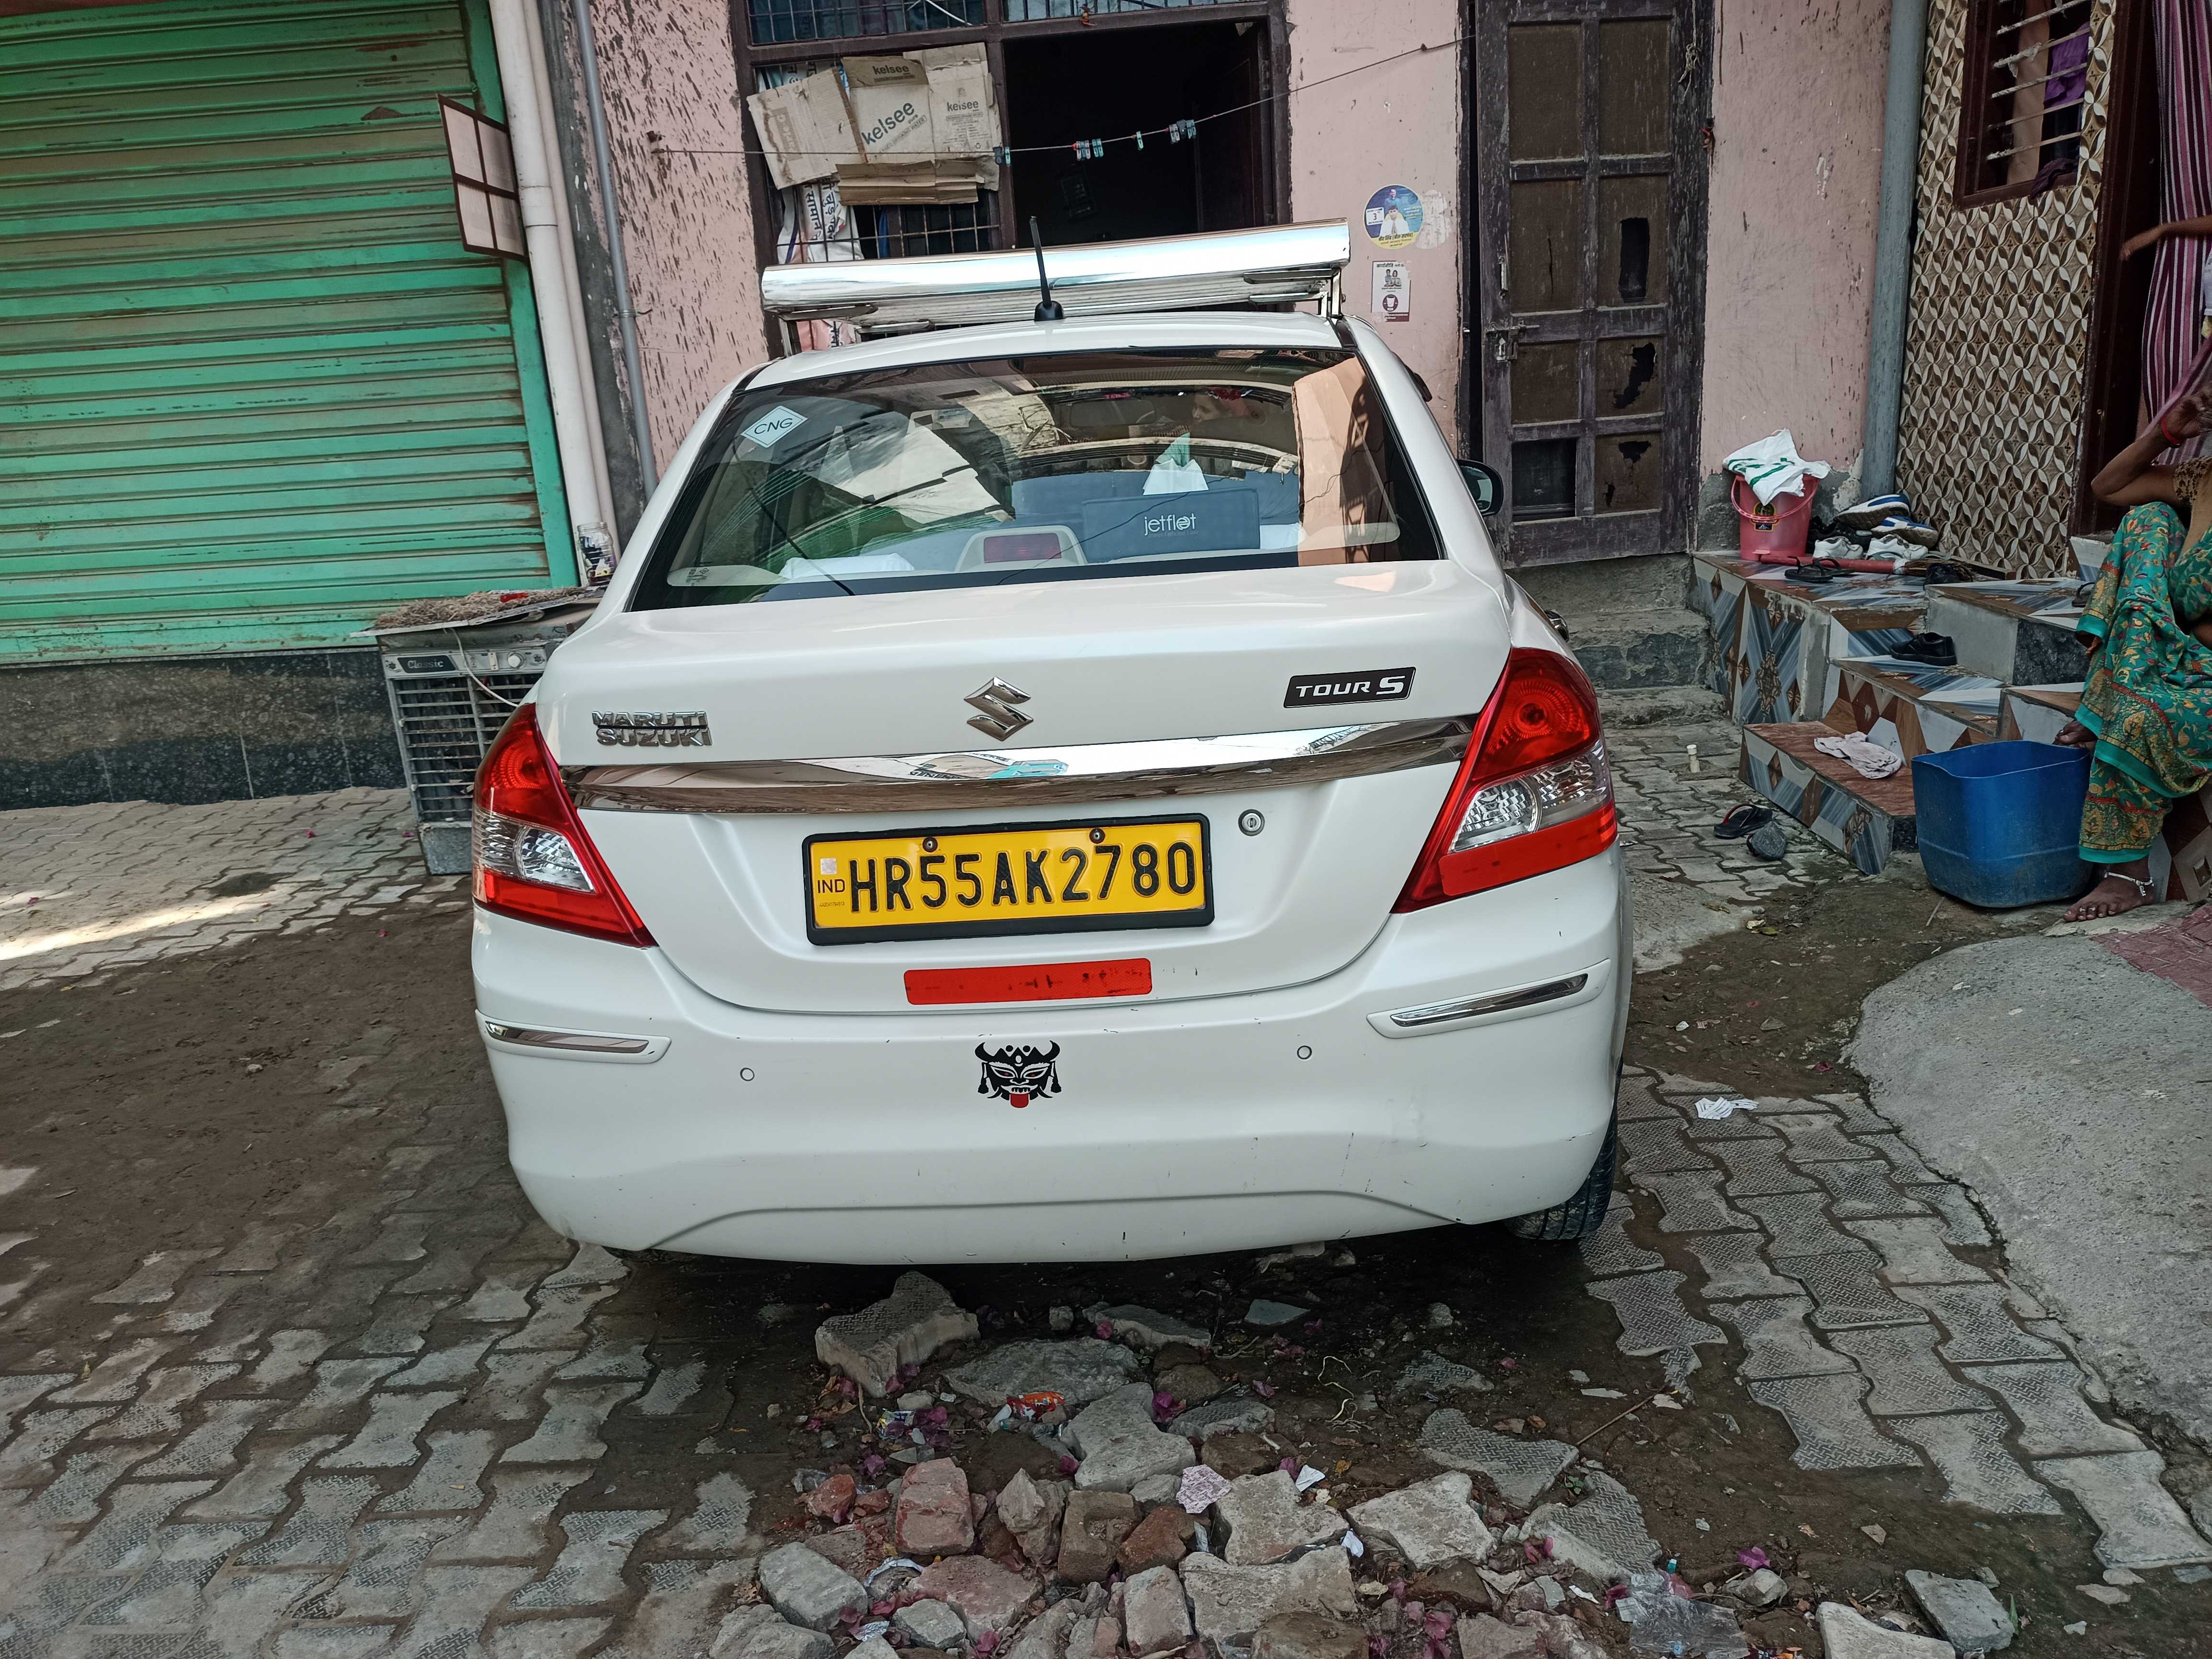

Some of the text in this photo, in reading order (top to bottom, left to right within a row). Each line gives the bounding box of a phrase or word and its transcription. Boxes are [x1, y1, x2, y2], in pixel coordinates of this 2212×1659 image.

[872, 65, 909, 74] kelsee
[861, 102, 914, 145] kelsee
[806, 191, 822, 230] सामान
[754, 418, 793, 434] CNG
[408, 660, 444, 669] Classic
[1296, 675, 1406, 697] TOUR S
[591, 710, 709, 727] MARUTI
[596, 726, 713, 747] SUZUKI
[817, 878, 845, 893] IND
[849, 841, 1197, 914] HR55AK2780
